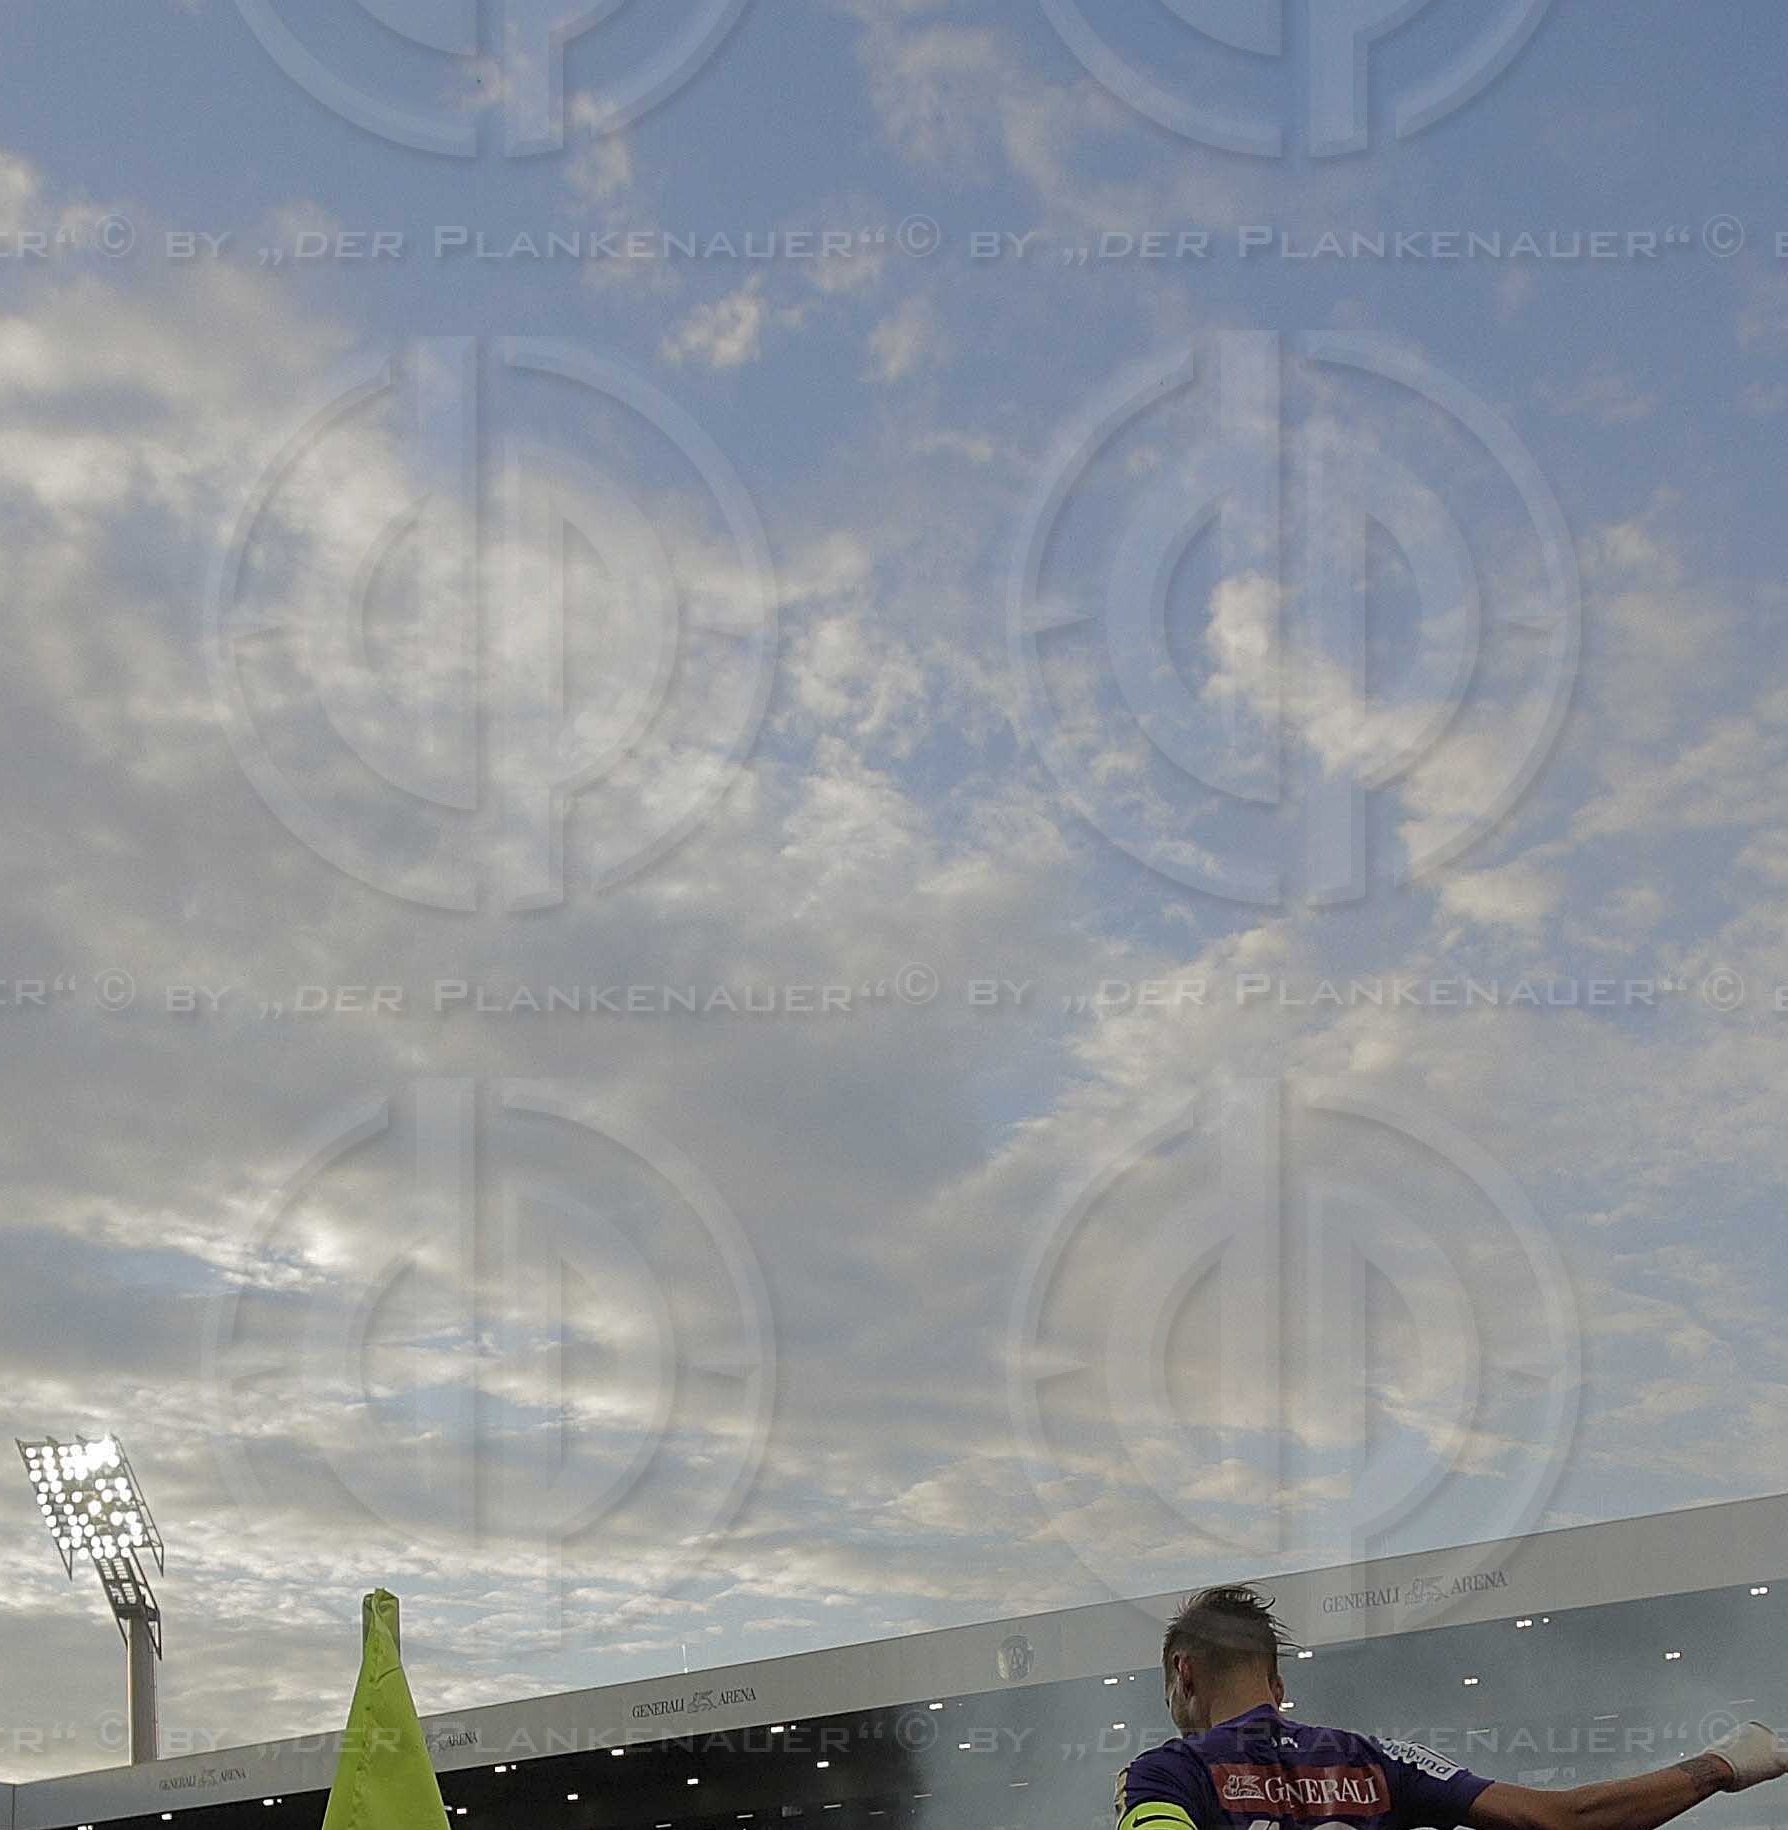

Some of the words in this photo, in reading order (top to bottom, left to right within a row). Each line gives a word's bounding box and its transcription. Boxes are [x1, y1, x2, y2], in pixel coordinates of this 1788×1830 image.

[1323, 1586, 1400, 1613] GENERALI
[1450, 1571, 1508, 1596] ARENA
[632, 1698, 685, 1718] GENERALI
[718, 1687, 757, 1705] ARENA
[446, 1731, 478, 1746] ARENA
[1265, 1776, 1380, 1805] GNERALI
